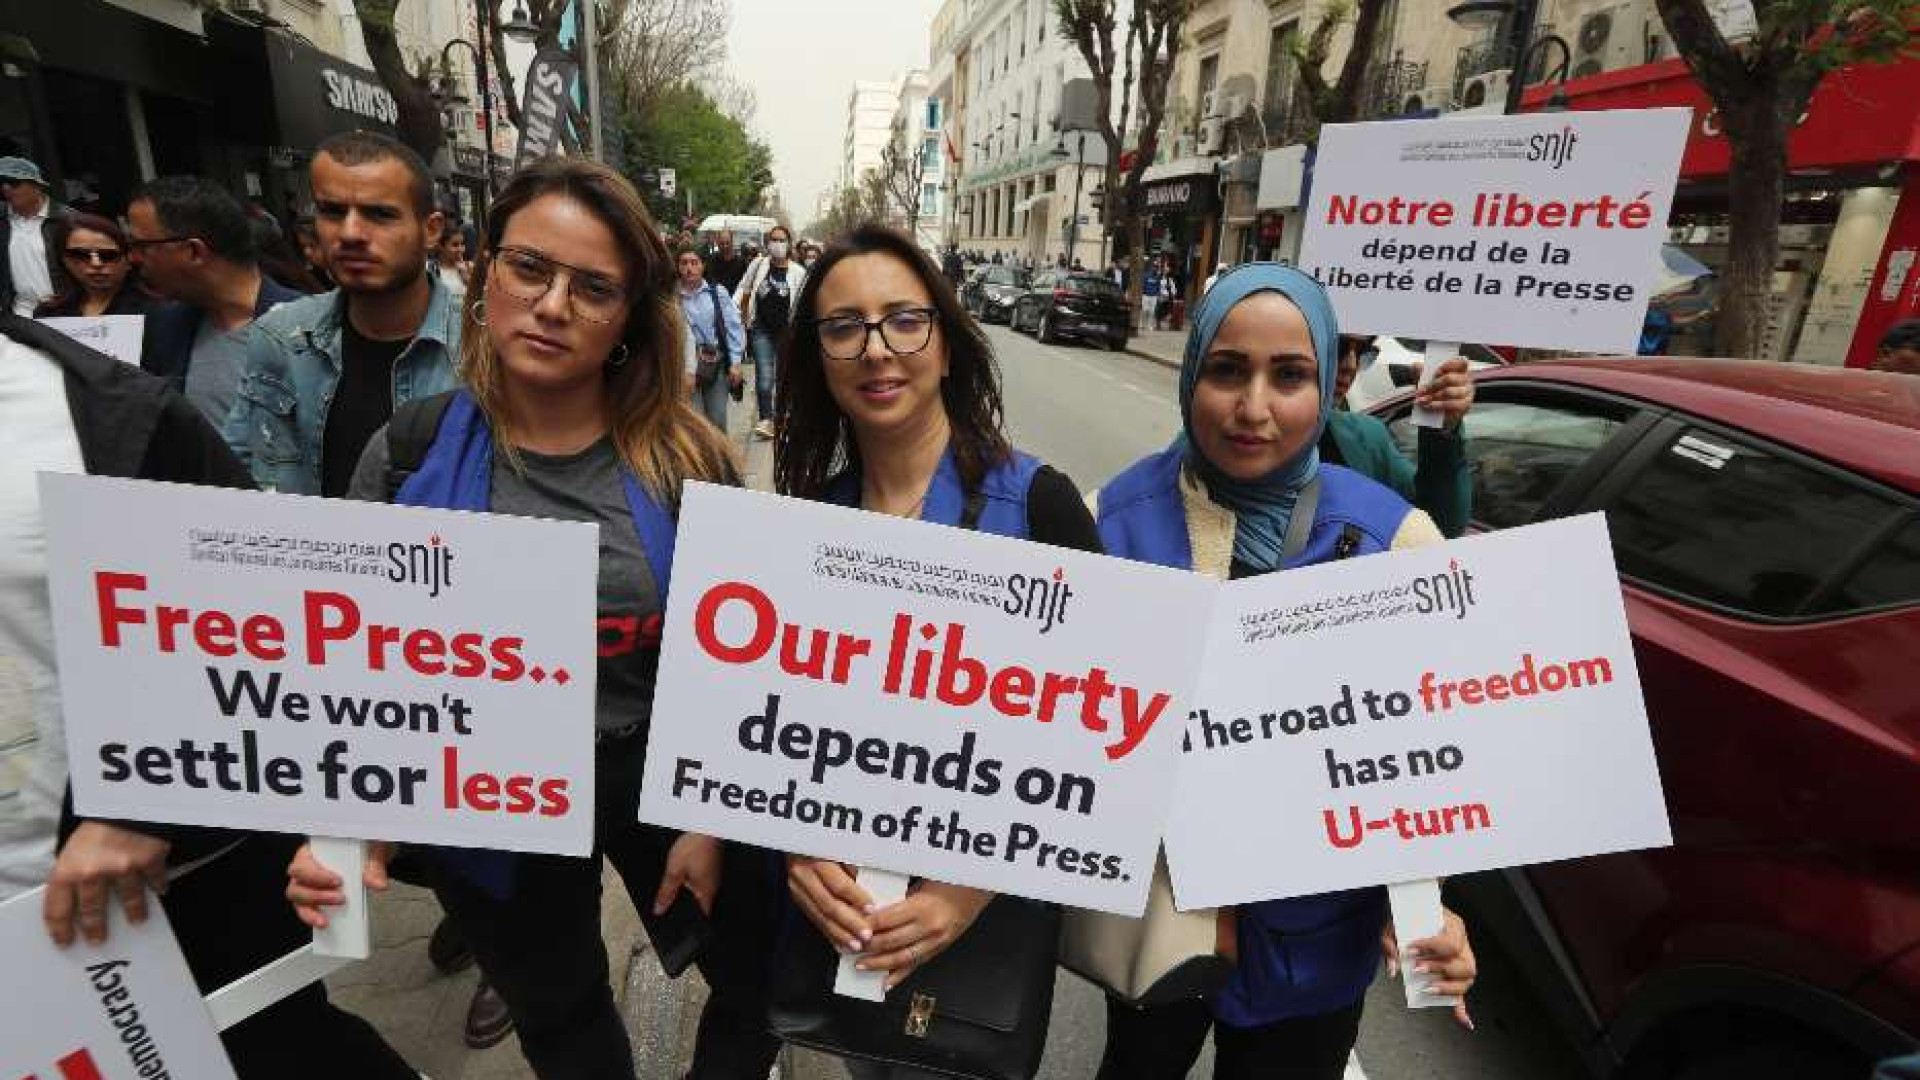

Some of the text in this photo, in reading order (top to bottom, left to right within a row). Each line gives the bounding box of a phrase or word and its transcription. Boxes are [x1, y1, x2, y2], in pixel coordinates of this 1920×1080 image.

[1327, 191, 1652, 230] Notre liberté
[1361, 238, 1571, 267] dépend de la
[1425, 271, 1462, 293] de
[1474, 273, 1502, 296] la
[1514, 275, 1635, 304] Presse
[388, 532, 455, 598] snjt
[1412, 557, 1478, 620] snjt
[96, 571, 570, 685] Free Press..
[1003, 567, 1074, 635] snjt
[205, 666, 473, 736] We won't
[693, 581, 1171, 762] Our liberty
[1259, 684, 1358, 740] road
[1361, 690, 1411, 727] to
[1419, 655, 1615, 710] freedom
[98, 729, 571, 818] settle for less
[738, 694, 1096, 816] depends on
[1324, 744, 1463, 790] has no
[672, 756, 1132, 884] Freedom of the Press.
[1323, 803, 1491, 850] U-turn
